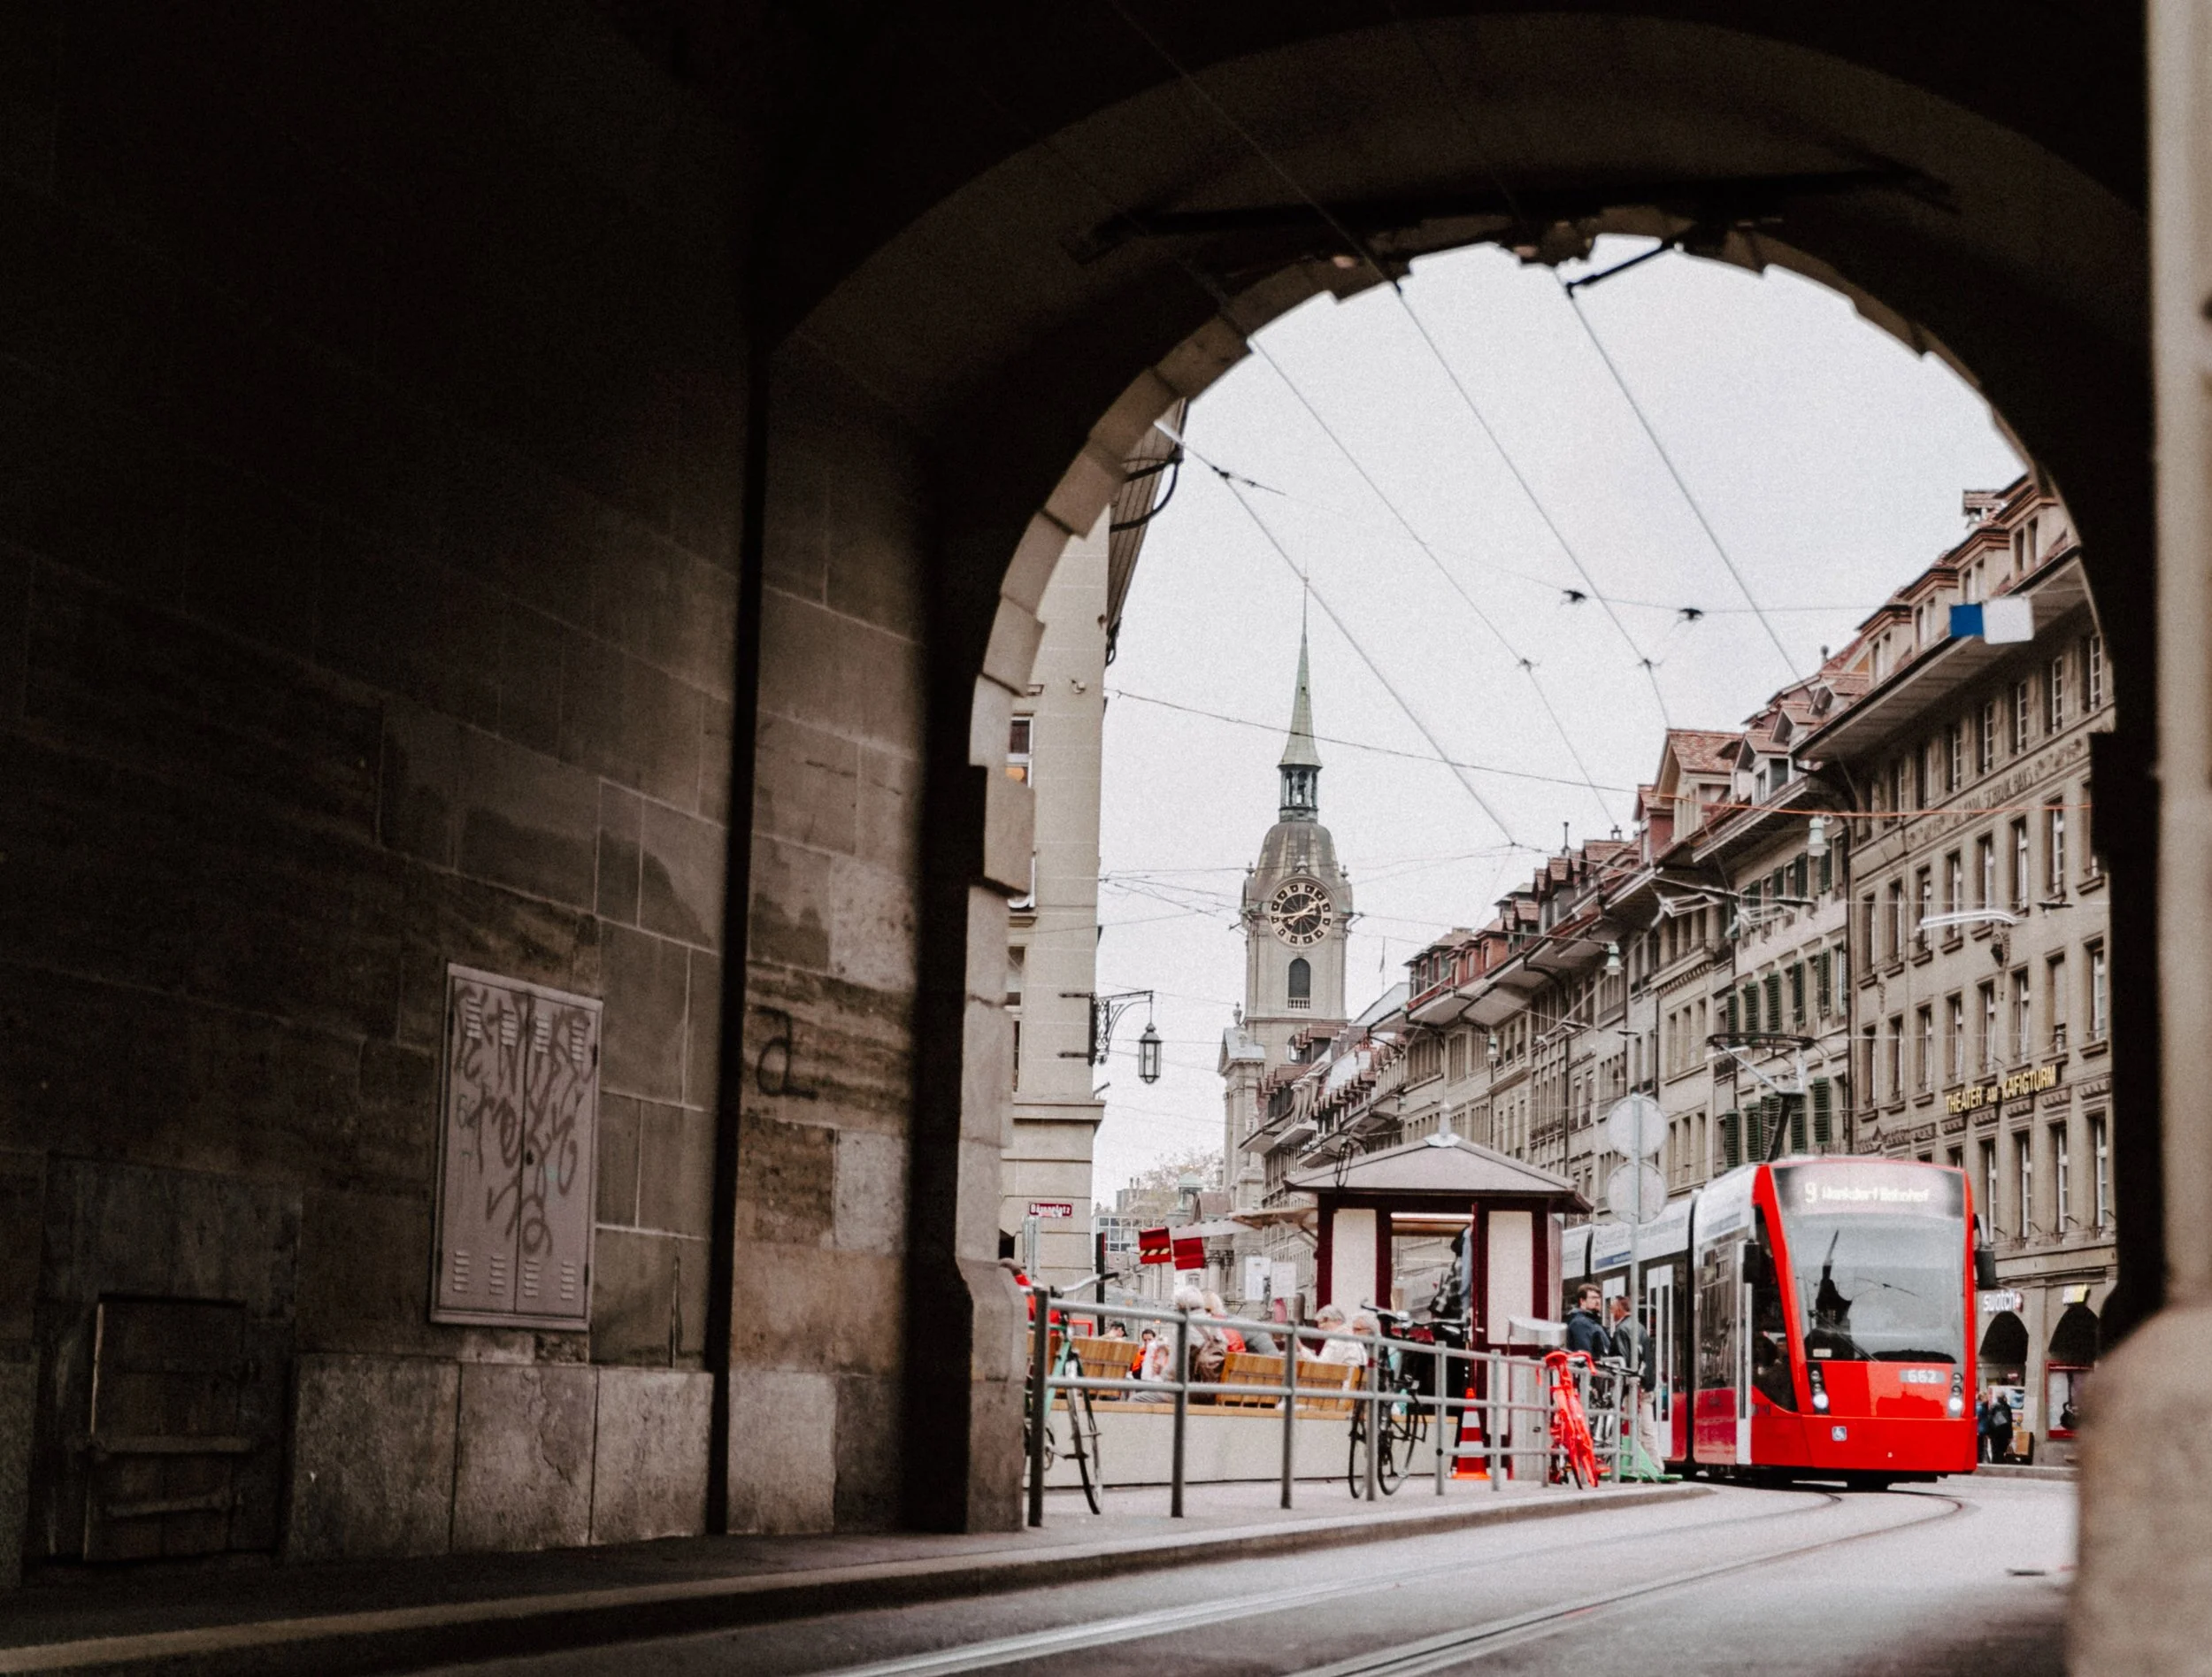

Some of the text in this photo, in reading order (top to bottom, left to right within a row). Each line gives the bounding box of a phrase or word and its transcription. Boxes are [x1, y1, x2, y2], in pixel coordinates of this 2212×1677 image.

[1946, 1086, 1983, 1114] THEATER
[1805, 1182, 1816, 1203] 9
[1983, 1289, 2016, 1312] swatch
